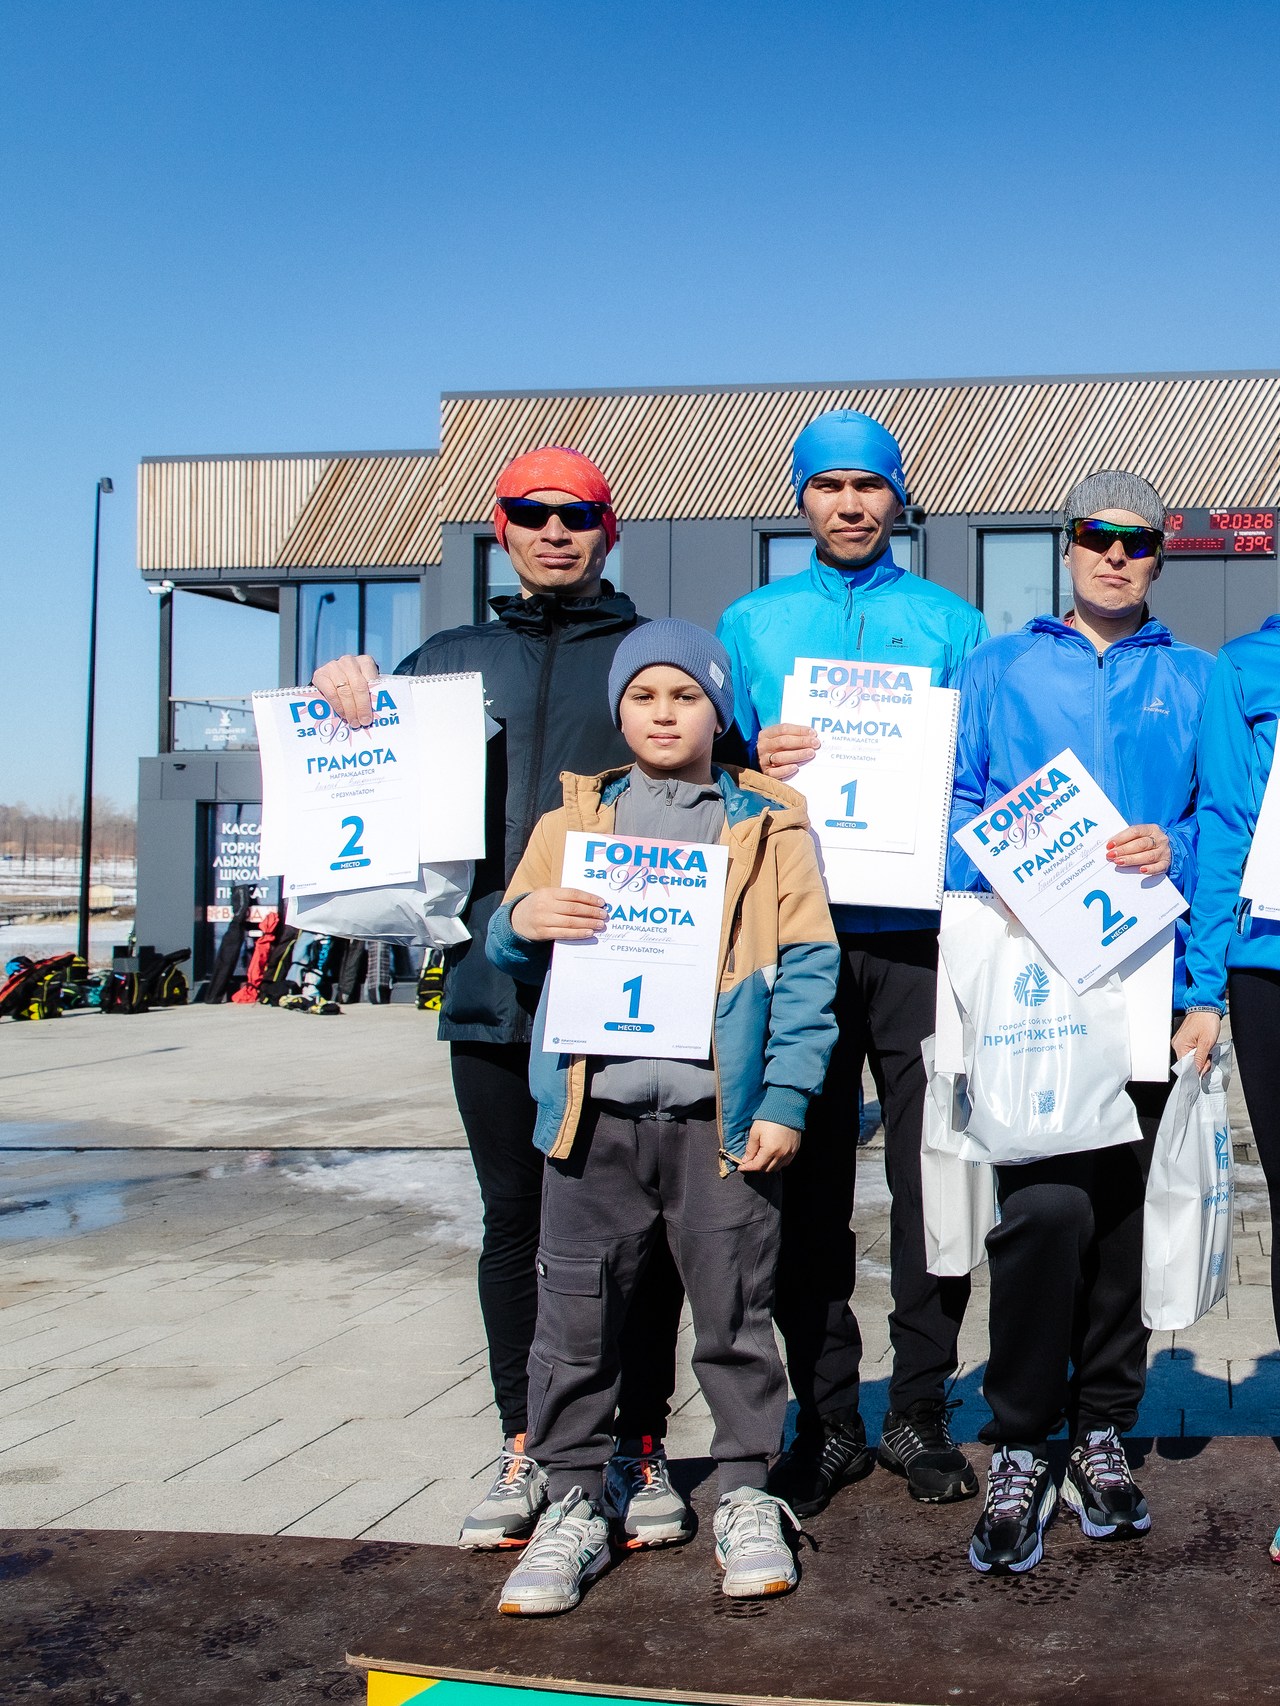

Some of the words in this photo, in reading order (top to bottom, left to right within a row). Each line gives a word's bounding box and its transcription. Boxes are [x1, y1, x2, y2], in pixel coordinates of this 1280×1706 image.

[810, 666, 913, 691] ГОНКА
[289, 690, 397, 723] ГОА
[809, 689, 828, 698] за
[830, 686, 912, 708] Весной
[296, 727, 317, 738] за
[811, 717, 902, 738] ГРАМОТА
[832, 735, 879, 744] НАГРАЖДАЕТСЯ
[307, 748, 397, 774] ГРАМОТА
[835, 754, 876, 762] РЕЗУЛЬТАТОМ
[330, 768, 375, 780] НАГРАЖДАЕТСЯ
[335, 788, 375, 798] РЕЗУЛЬТАТОМ
[841, 779, 858, 817] 1
[972, 767, 1072, 846] ГОНКА
[990, 840, 1010, 857] за
[1008, 782, 1081, 850] Весной
[338, 815, 364, 858] 2
[585, 841, 708, 873] ГОНКА
[1012, 816, 1098, 884] ГРАМОТА
[1042, 842, 1085, 877] НАГРАЖДАЕТСЯ
[340, 861, 361, 869] МЕСТО
[1060, 859, 1096, 888] РЕЗУЛЬТАТОМ
[583, 868, 607, 880] за
[608, 865, 707, 893] Весной
[604, 903, 695, 926] РАМОТА
[1083, 889, 1125, 934] 2
[611, 924, 668, 934] НАГРАЖДАЕТСЯ
[1111, 924, 1129, 940] МЕСТО
[616, 945, 665, 954] РЕЗУЛЬТАТОМ
[623, 974, 643, 1018] 1
[617, 1024, 642, 1032] МЕСТО
[983, 1024, 1088, 1047] ПРИТЯЖЕНИЕ
